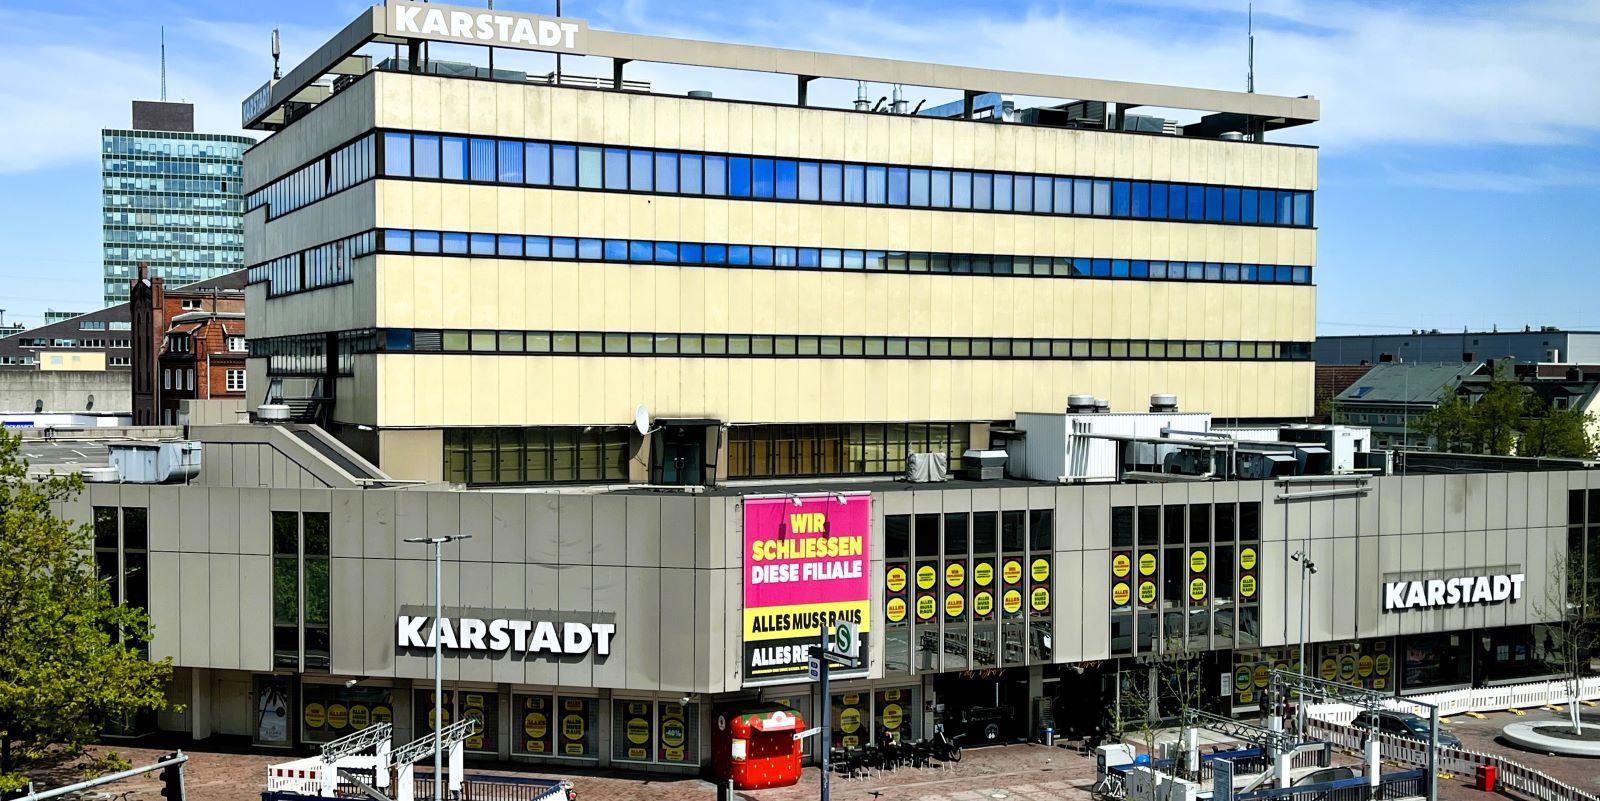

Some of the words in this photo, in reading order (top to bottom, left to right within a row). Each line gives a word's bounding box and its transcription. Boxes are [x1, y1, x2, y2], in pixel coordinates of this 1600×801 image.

[394, 4, 578, 48] KARSTADT
[790, 512, 826, 534] WIR
[752, 536, 862, 561] SCHLIESSEN
[752, 563, 800, 584] DIESE
[802, 560, 862, 581] FILIALE
[1386, 574, 1524, 609] KARSTADT
[752, 614, 790, 633] ALLES
[792, 611, 826, 630] MUSS
[398, 616, 615, 655] KARSTADT
[838, 627, 849, 650] S
[752, 646, 792, 667] ALLES
